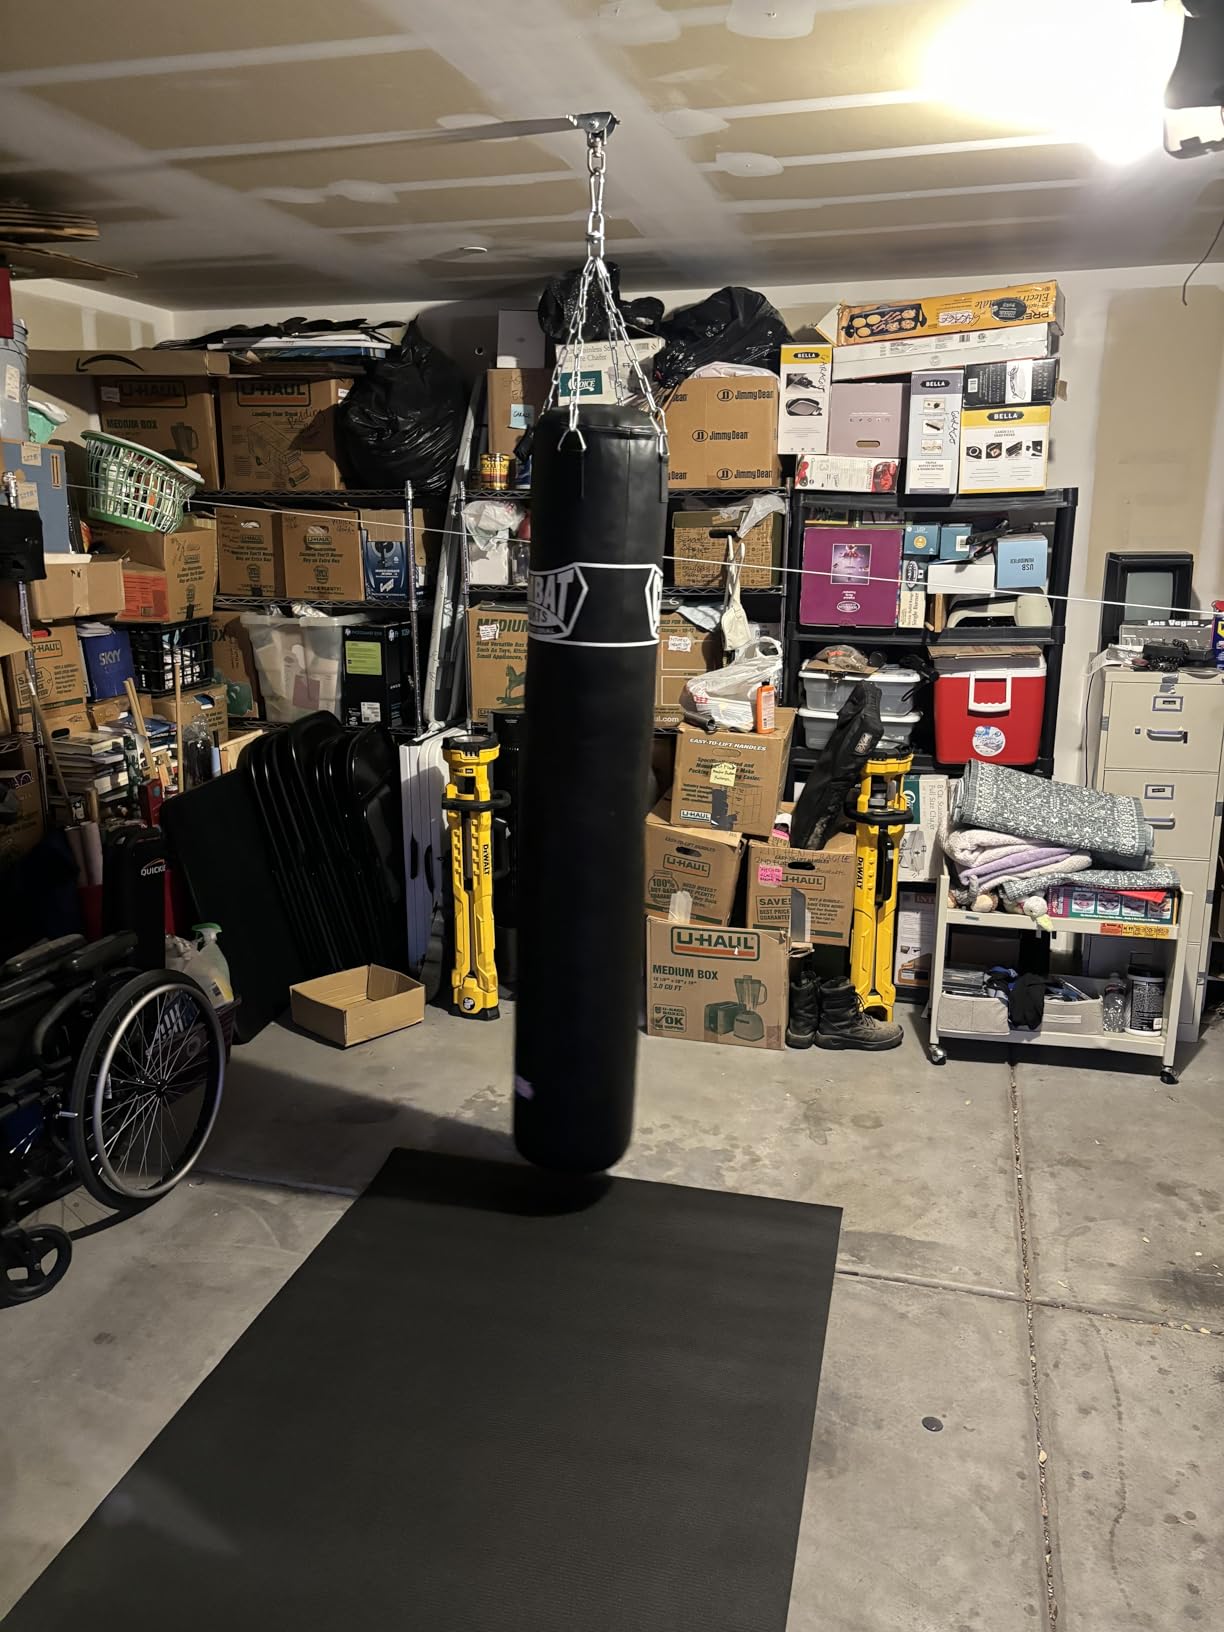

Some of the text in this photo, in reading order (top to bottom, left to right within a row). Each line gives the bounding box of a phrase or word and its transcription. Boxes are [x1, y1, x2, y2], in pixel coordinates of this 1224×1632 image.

[1019, 309, 1049, 321] PRE
[735, 390, 757, 400] Jimmy
[993, 412, 1018, 420] BELLA
[709, 430, 749, 441] Jimmy Dean
[671, 470, 688, 480] Dean
[734, 470, 756, 480] Jimmy
[1021, 563, 1034, 571] USB
[535, 569, 575, 622] BAT
[1168, 619, 1199, 627] Vegas
[99, 649, 121, 666] SKYY
[734, 743, 767, 752] HANDLES
[681, 810, 710, 820] U-HAUL
[667, 856, 707, 872] U-HAUL
[652, 878, 676, 889] 100%
[760, 897, 791, 906] SAVE!
[676, 931, 754, 950] U-HAUL
[652, 964, 719, 980] MEDIUM BOX
[664, 1016, 684, 1026] OK
